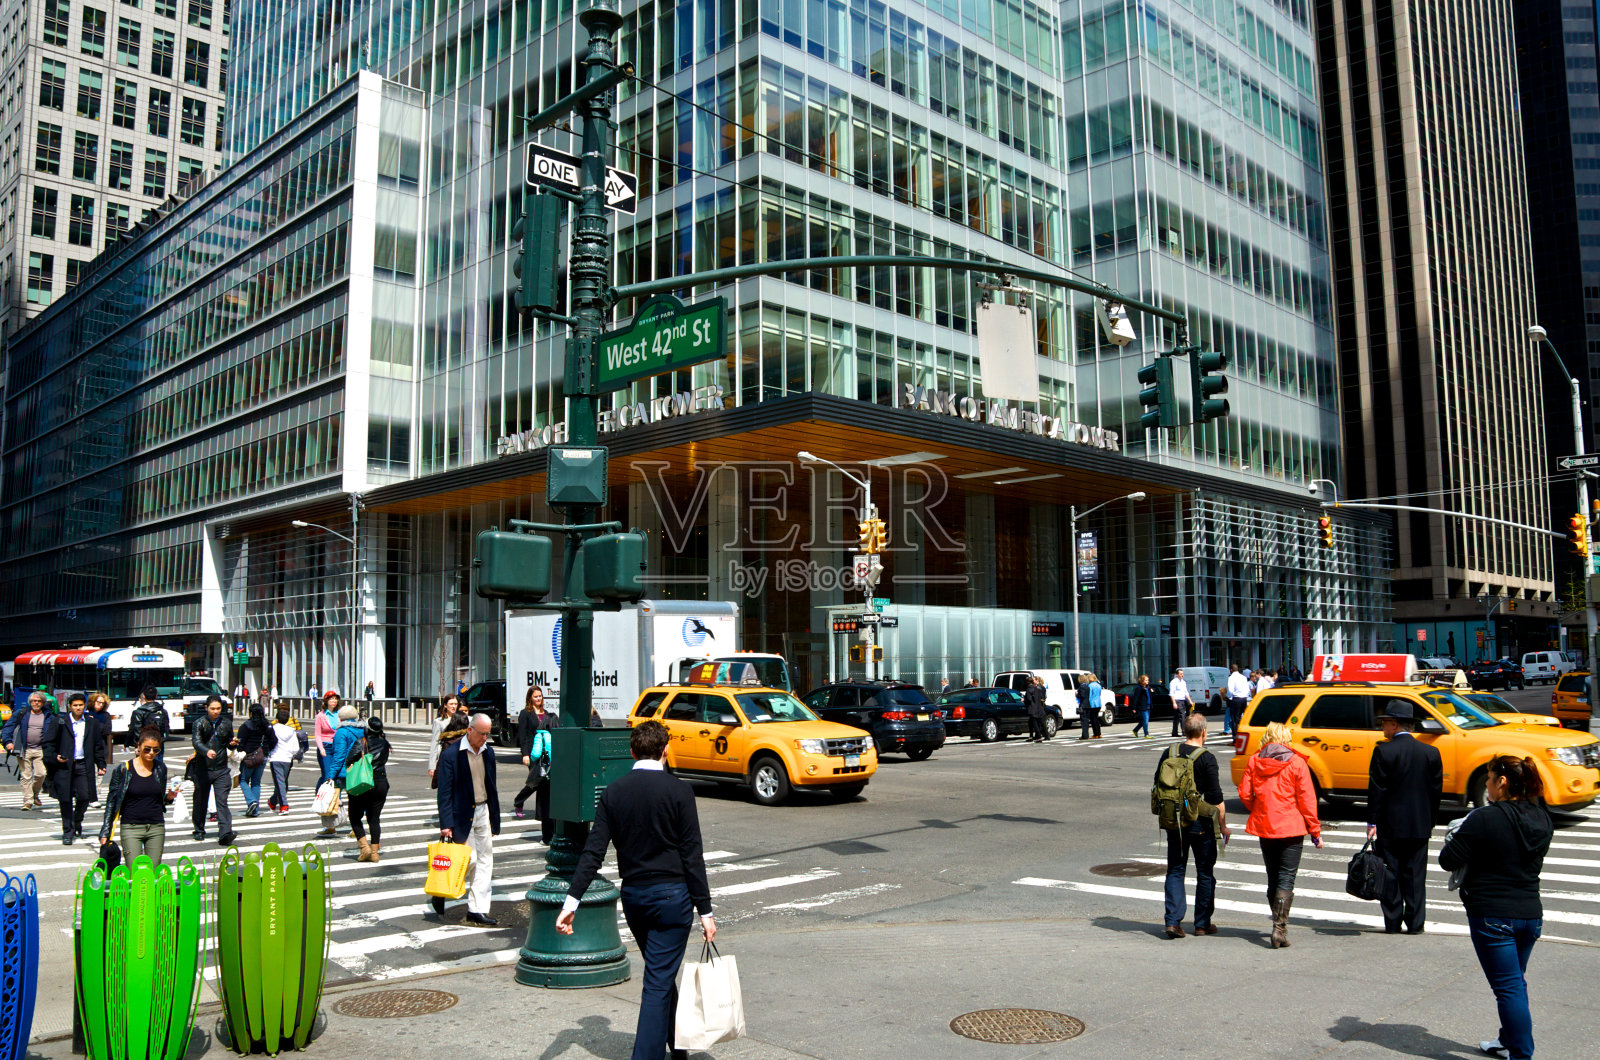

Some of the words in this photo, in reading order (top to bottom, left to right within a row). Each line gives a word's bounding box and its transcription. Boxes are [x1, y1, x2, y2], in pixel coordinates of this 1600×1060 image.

[538, 159, 574, 182] ONE
[604, 180, 630, 198] AY
[660, 310, 675, 319] PARK
[606, 337, 648, 371] West
[651, 318, 687, 357] 42nd
[692, 317, 711, 348] St
[497, 427, 543, 456] BANK
[597, 402, 649, 434] ERICA
[650, 384, 725, 421] TOWER
[898, 382, 958, 416] BANK
[959, 396, 985, 422] OF
[987, 403, 1069, 440] AMERICA
[1066, 421, 1120, 452] TOWER
[526, 671, 550, 686] BML
[547, 688, 560, 696] Thea
[432, 859, 451, 867] STRAND
[269, 867, 277, 893] PARK
[269, 896, 277, 936] BRYANT
